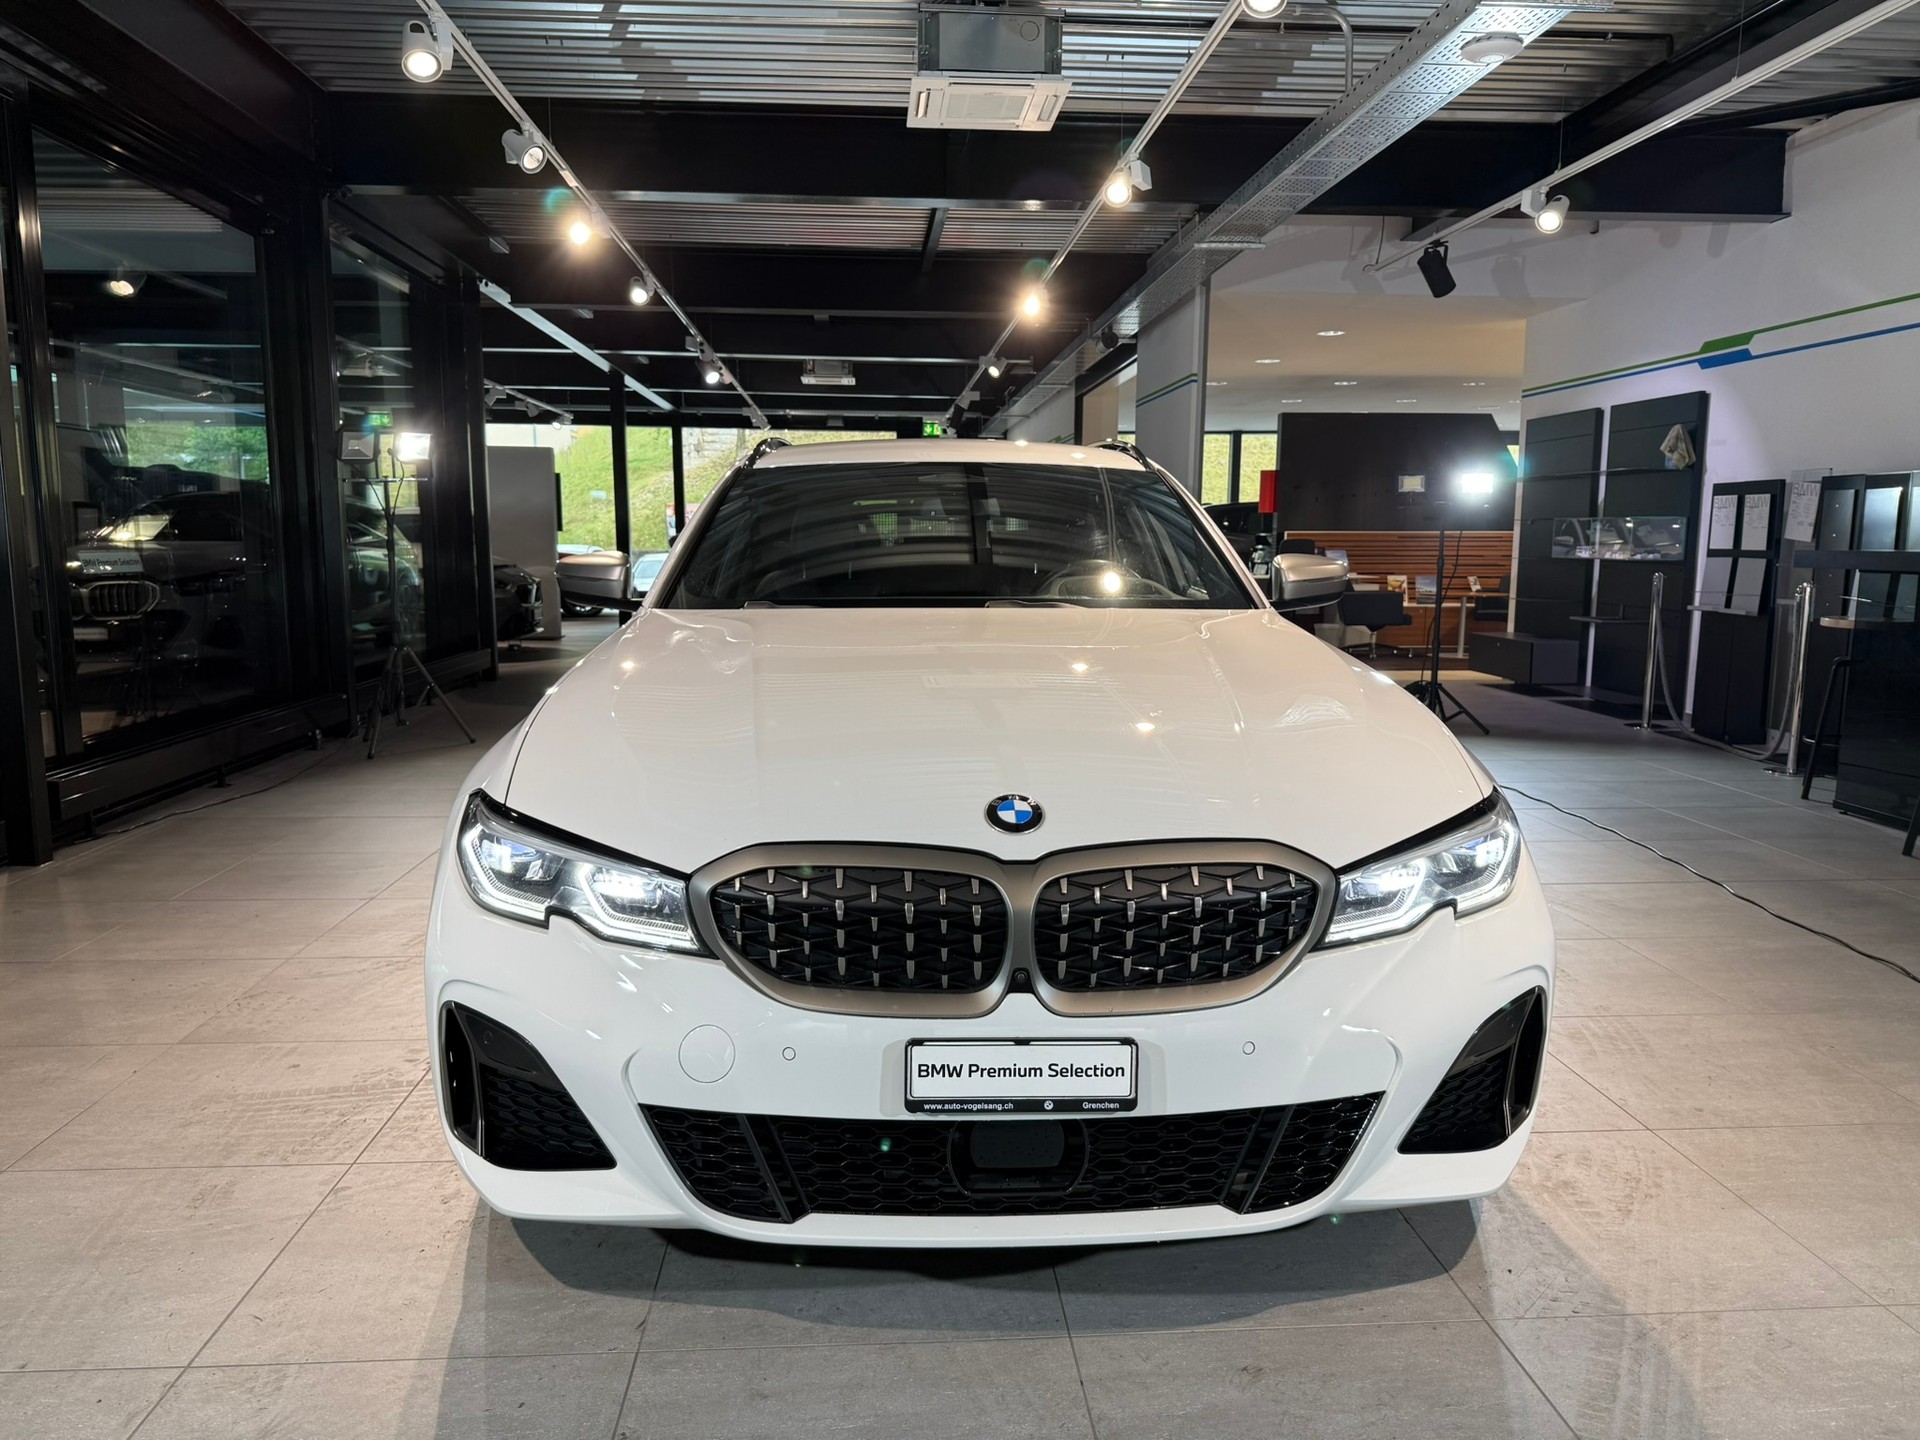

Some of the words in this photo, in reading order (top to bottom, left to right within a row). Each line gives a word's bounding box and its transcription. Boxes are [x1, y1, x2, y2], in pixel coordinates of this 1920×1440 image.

[1793, 483, 1820, 497] BMW
[1714, 496, 1737, 508] BMW
[1745, 496, 1770, 508] BMW
[917, 1063, 964, 1078] BMW
[968, 1063, 1043, 1078] Premium
[1047, 1063, 1125, 1078] Selection
[923, 1101, 1014, 1111] www.auto-vogelsang.ch
[1082, 1101, 1120, 1110] Grenchen
